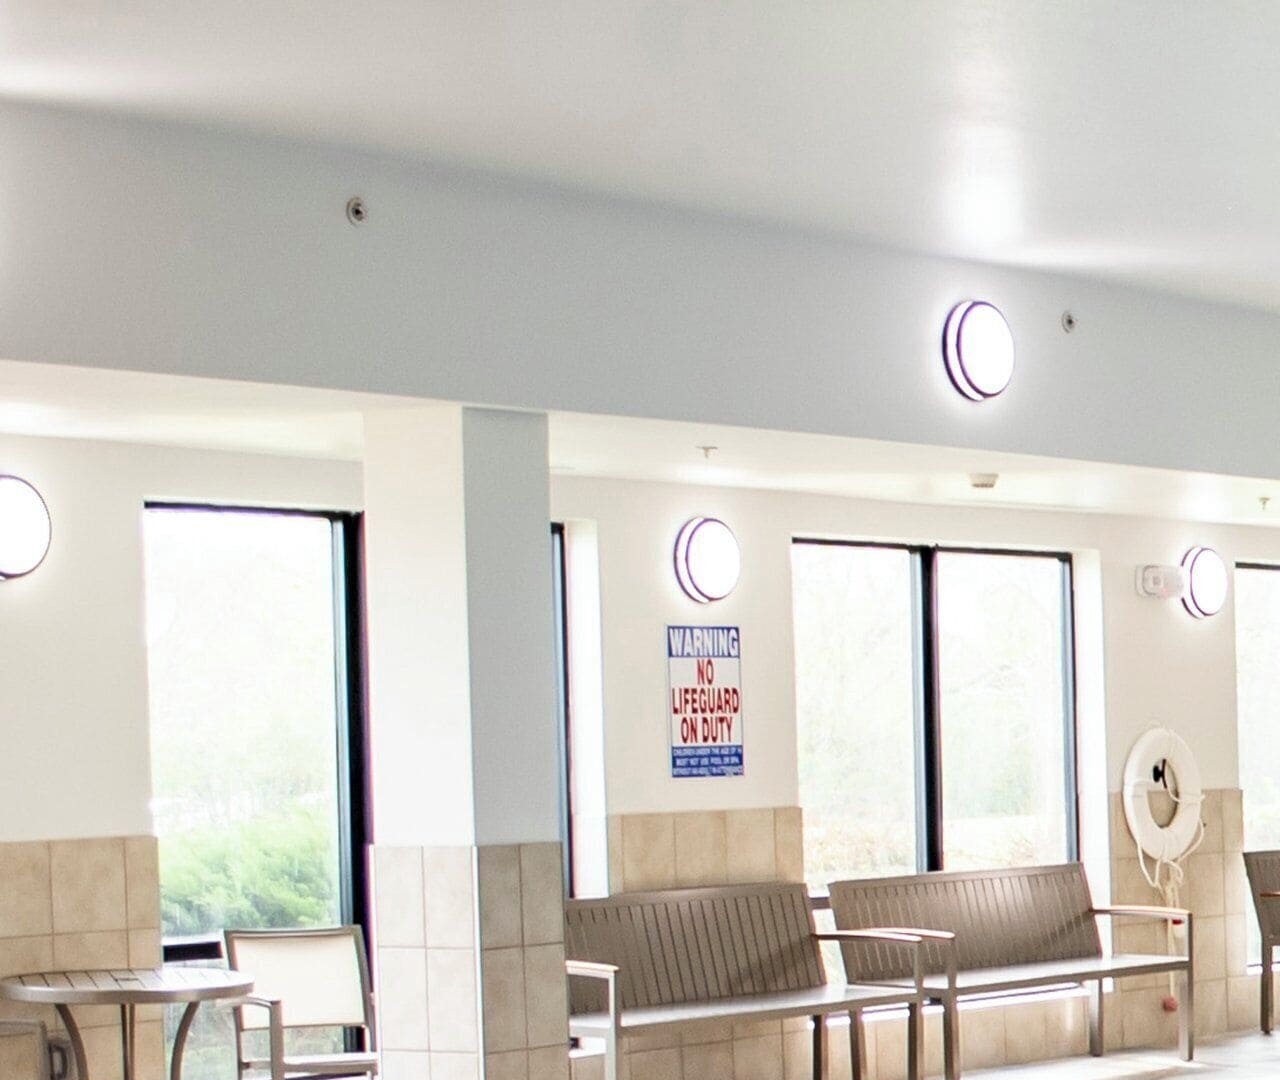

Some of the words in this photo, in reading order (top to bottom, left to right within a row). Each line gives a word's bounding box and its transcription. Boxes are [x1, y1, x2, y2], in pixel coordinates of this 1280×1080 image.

[669, 627, 740, 657] WARNING
[697, 659, 714, 686] NO
[672, 687, 740, 714] LIFEGUARD
[681, 716, 698, 743] ON
[702, 716, 734, 743] DUTY
